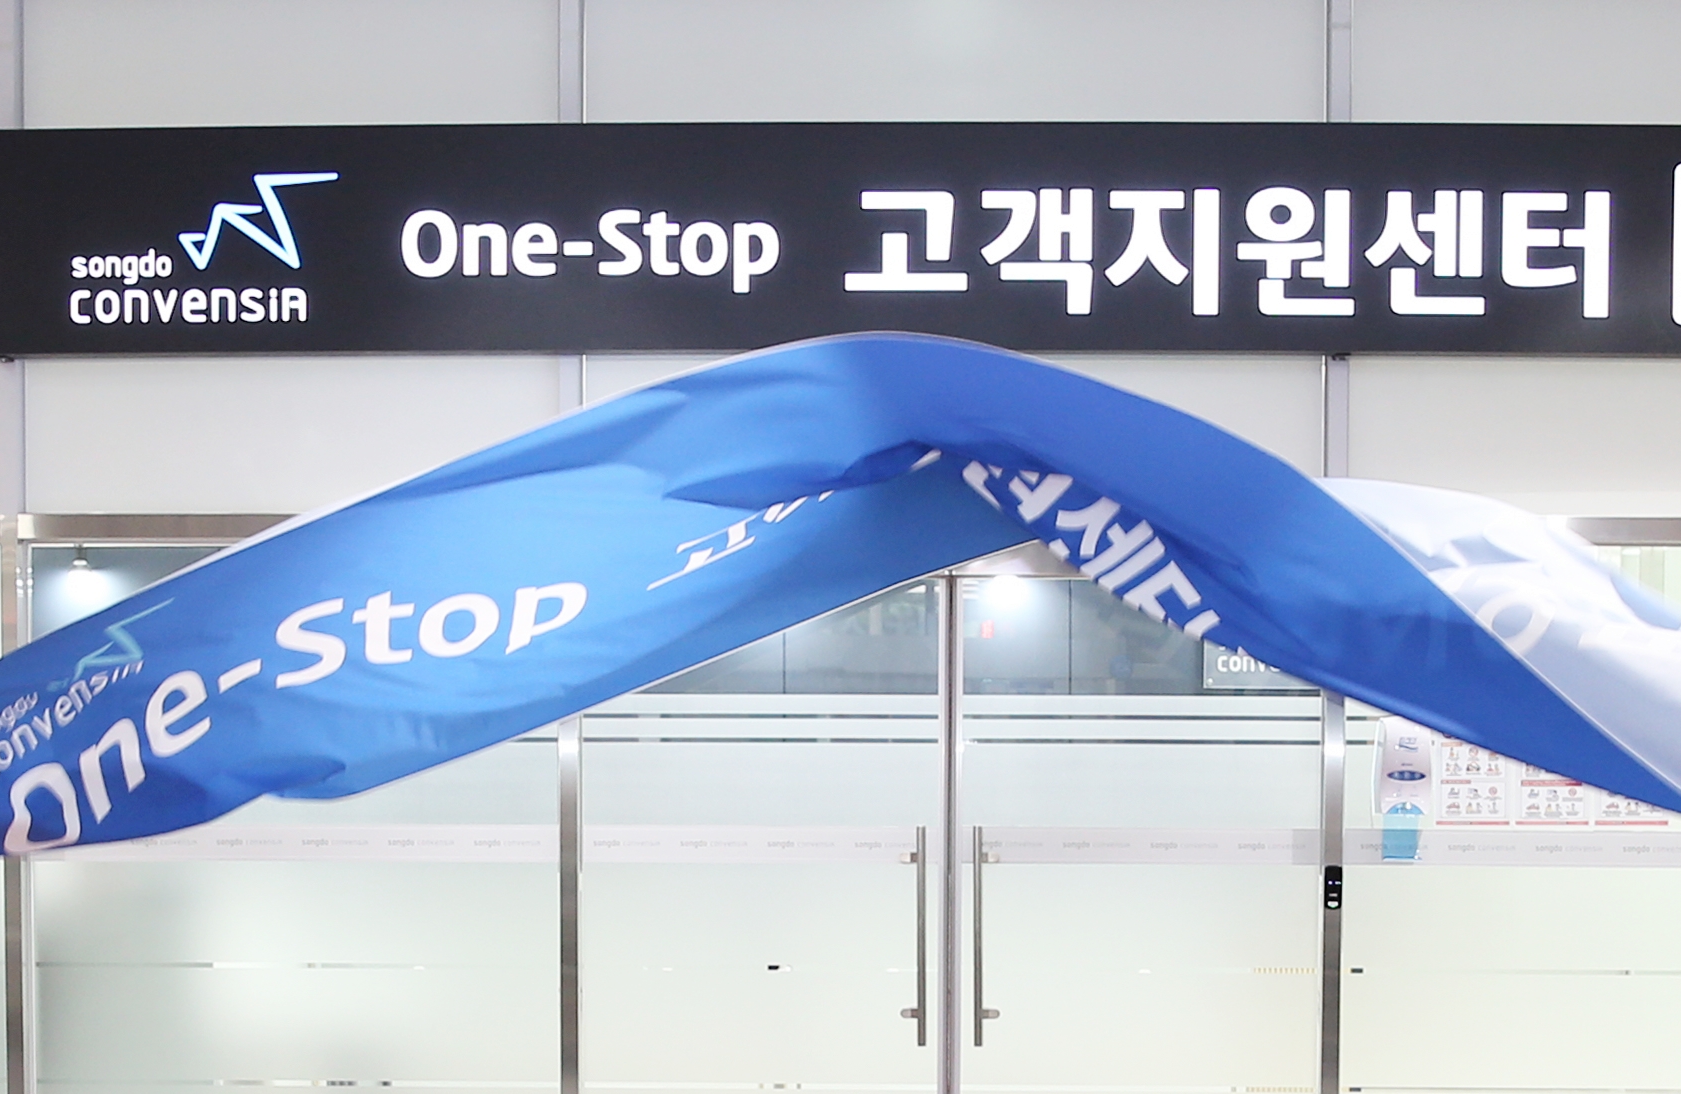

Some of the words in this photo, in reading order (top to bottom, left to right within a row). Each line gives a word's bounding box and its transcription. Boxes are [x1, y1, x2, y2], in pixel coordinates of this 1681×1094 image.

[71, 248, 173, 285] songdo
[400, 208, 780, 293] One-Stop
[843, 186, 1612, 320] 고객지원센터
[3, 582, 588, 856] One-Stop
